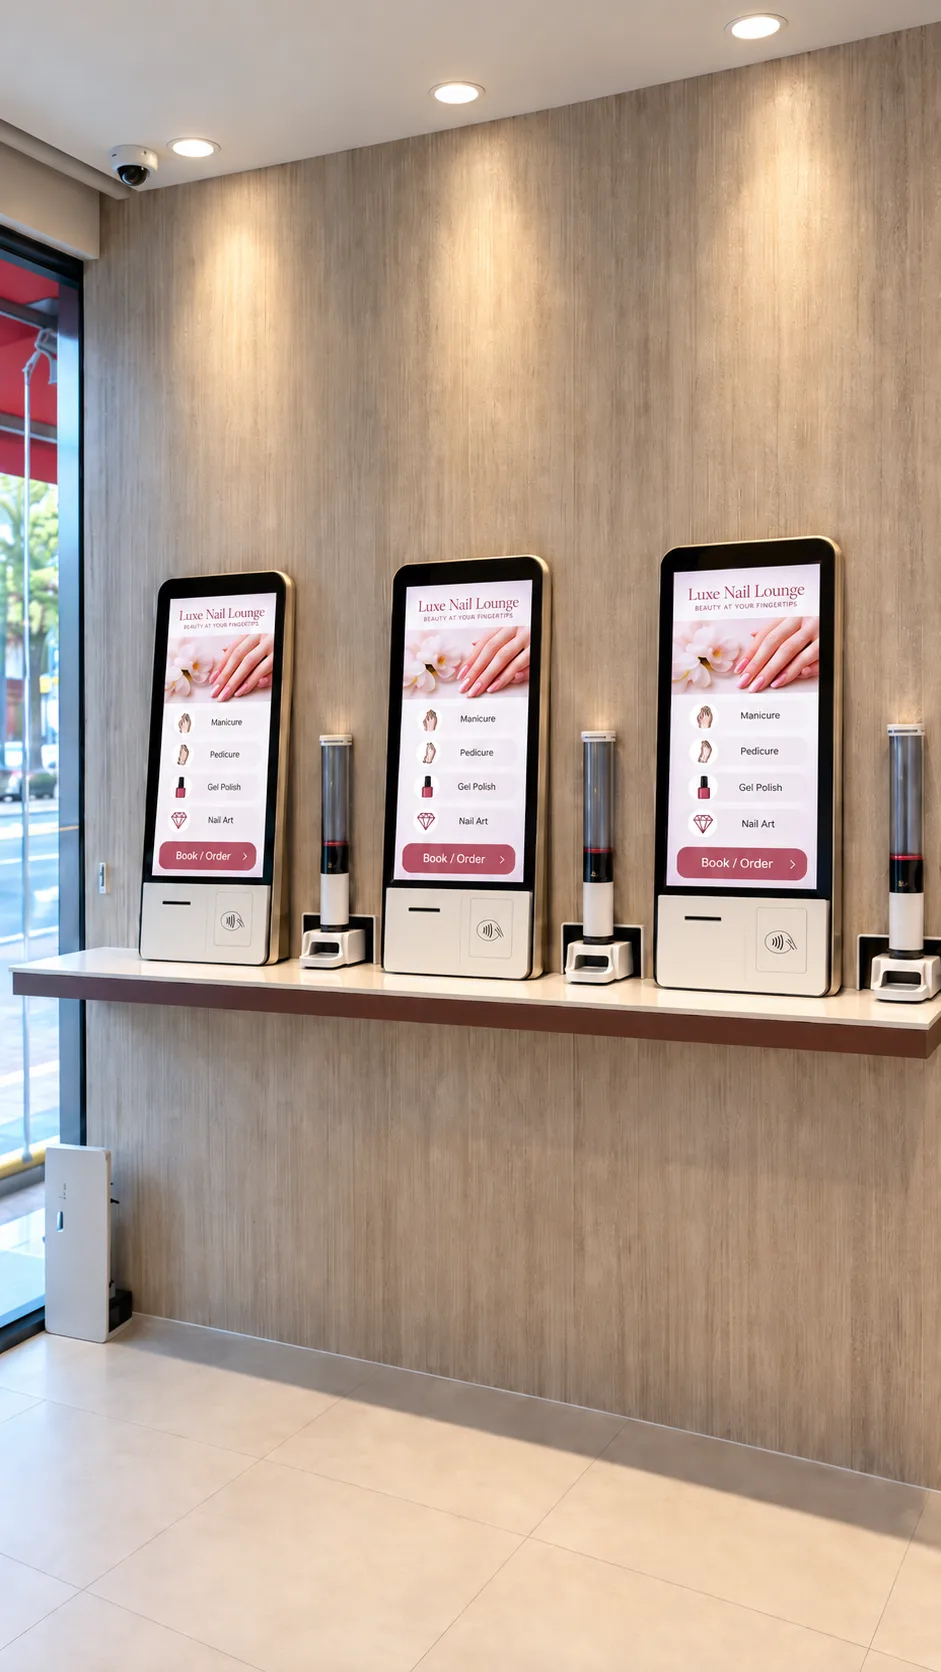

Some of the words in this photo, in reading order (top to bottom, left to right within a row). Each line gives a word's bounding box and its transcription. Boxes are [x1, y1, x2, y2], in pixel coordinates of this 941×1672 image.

[688, 588, 720, 600] Luxe
[724, 585, 750, 599] Nail
[755, 584, 805, 600] Lounge
[418, 601, 446, 612] Luxe
[450, 598, 472, 611] Nail
[476, 598, 519, 612] Lounge
[179, 610, 203, 620] Luxe
[206, 608, 225, 619] Nail
[228, 608, 265, 619] Lounge
[740, 711, 780, 719] Manicure
[176, 851, 198, 860] Book
[206, 851, 231, 860] Order
[423, 854, 447, 863] Book
[457, 854, 485, 863] Order
[701, 858, 730, 868] Book
[740, 858, 773, 868] Order
